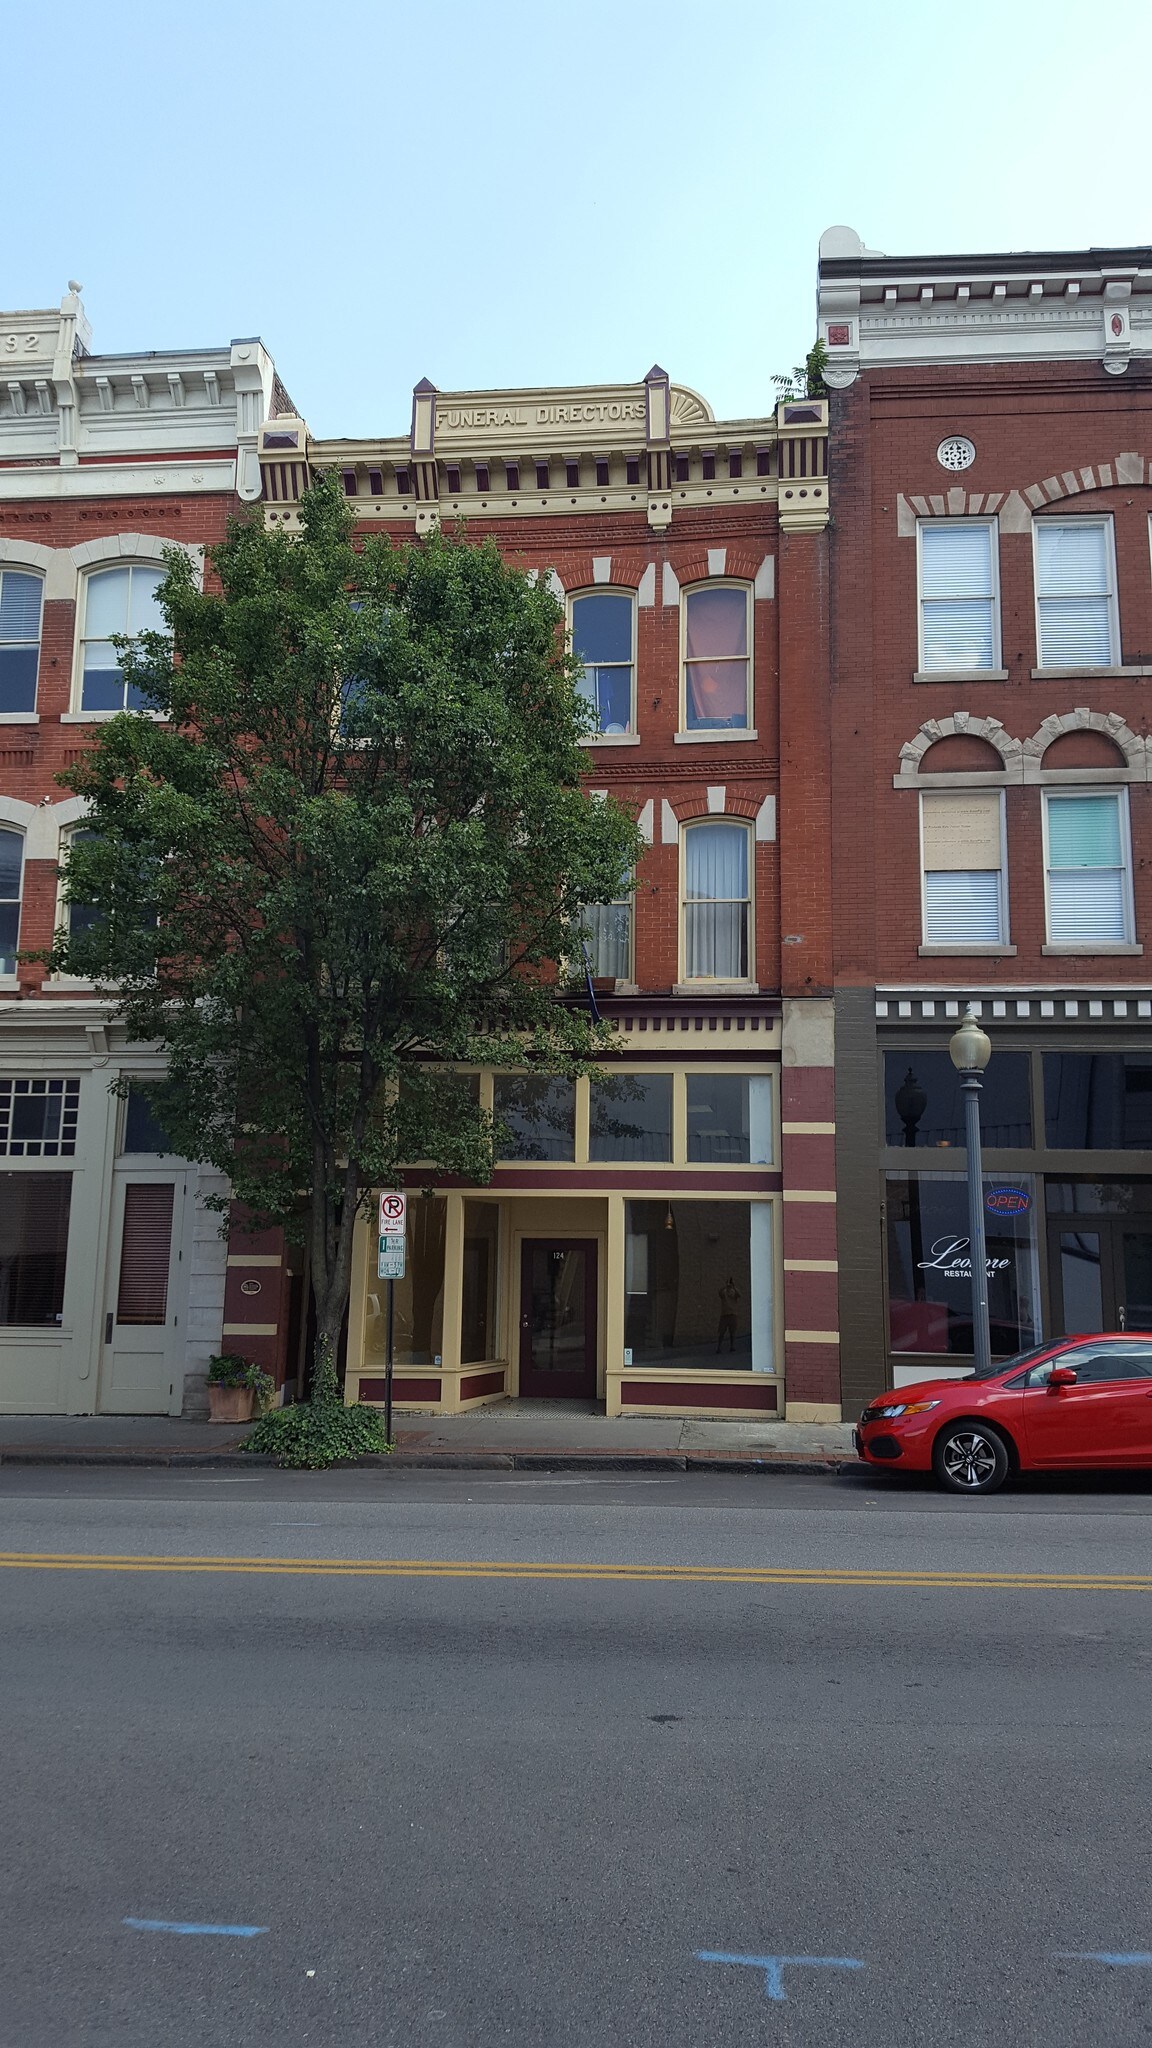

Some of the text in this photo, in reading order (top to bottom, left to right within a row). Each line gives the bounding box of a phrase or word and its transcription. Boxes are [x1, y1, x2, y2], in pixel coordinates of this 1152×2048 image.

[435, 402, 646, 428] FUNERAL DIRECTORS
[986, 1195, 1029, 1209] OPEN
[917, 1235, 1011, 1269] Leoore
[944, 1270, 995, 1278] RESTANT
